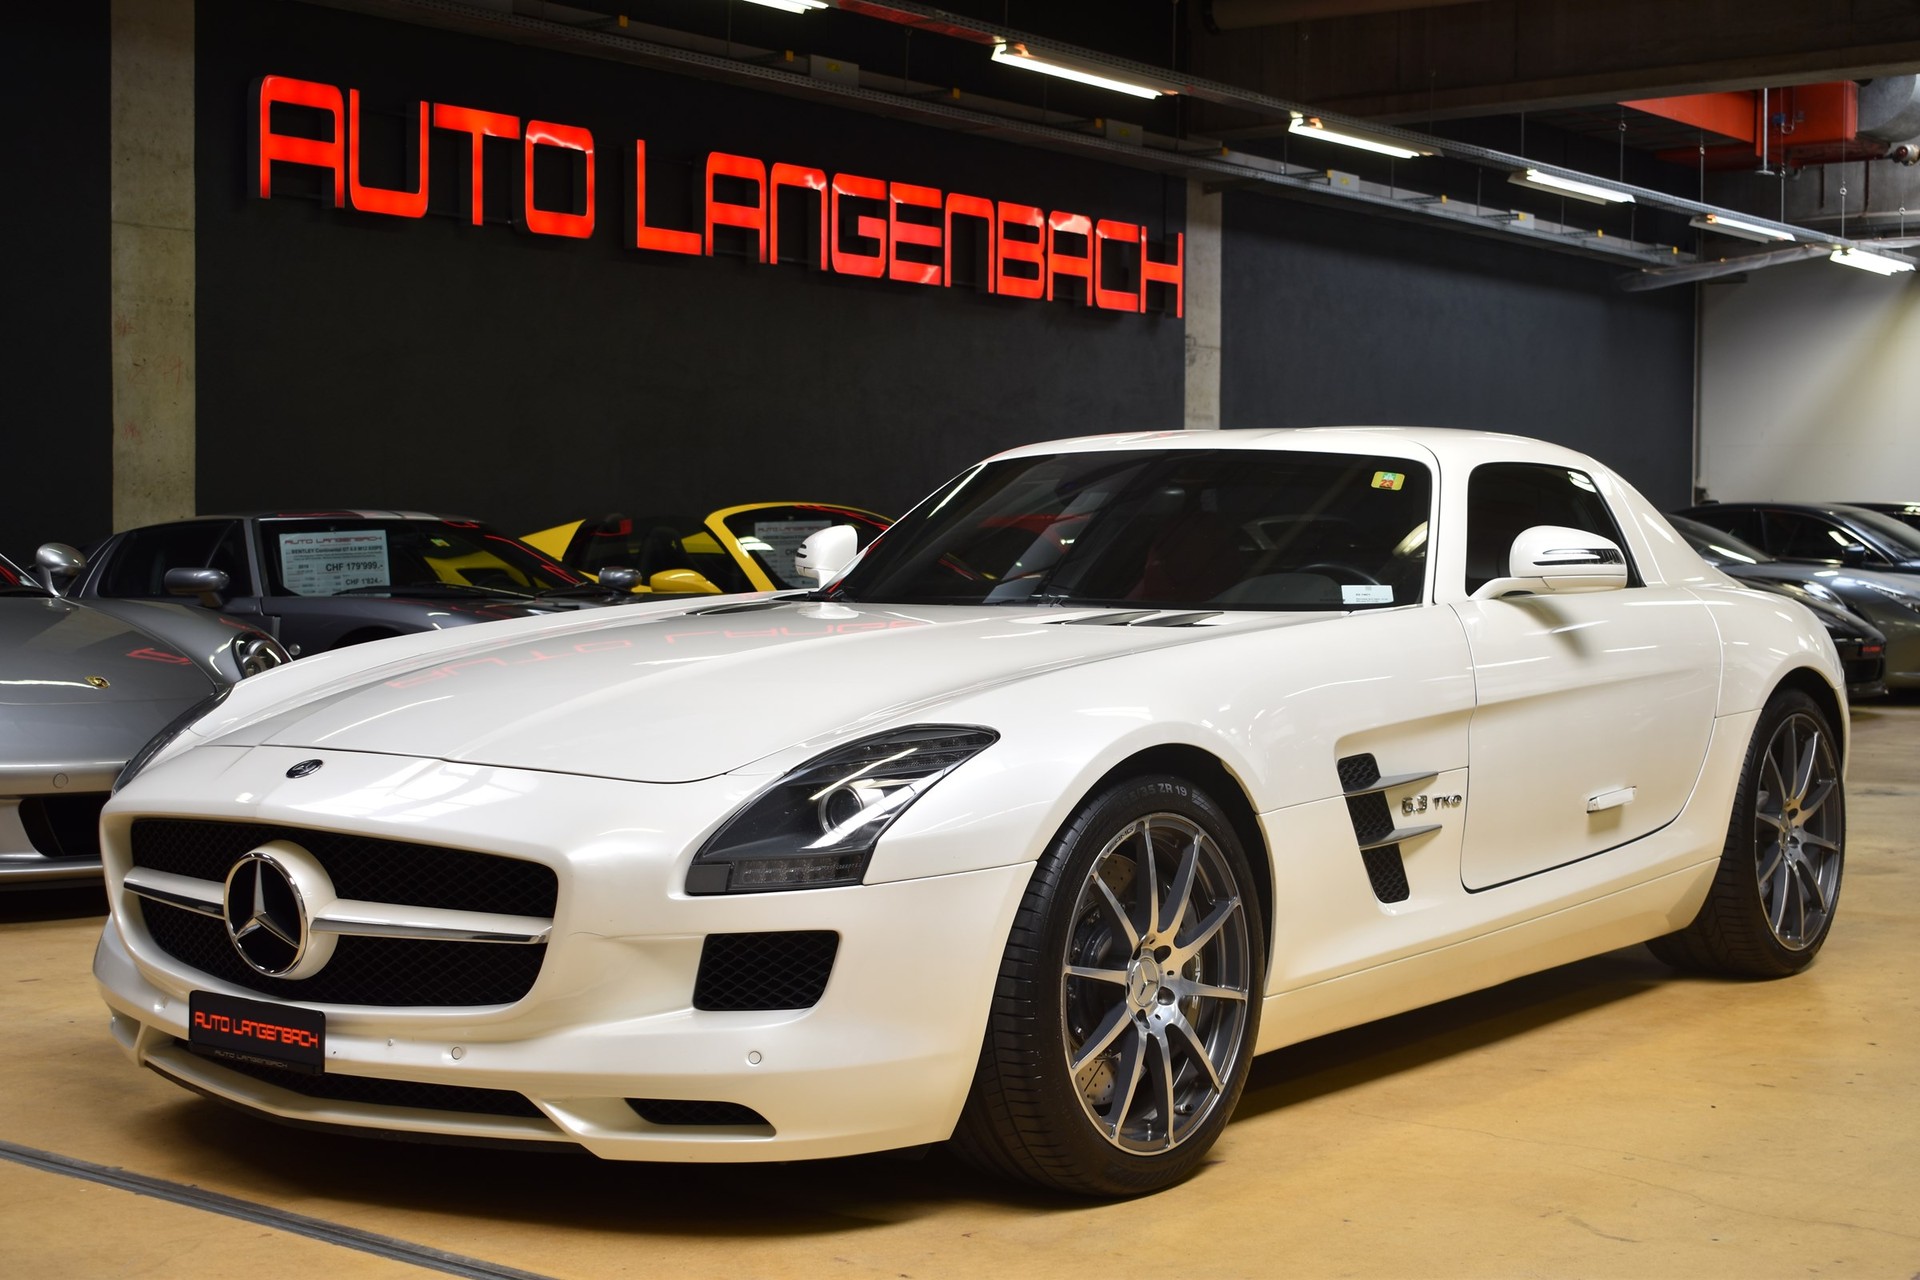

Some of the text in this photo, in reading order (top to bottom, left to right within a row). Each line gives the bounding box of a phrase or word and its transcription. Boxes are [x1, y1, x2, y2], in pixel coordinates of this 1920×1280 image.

[258, 74, 1184, 319] AUTO LANGENBACH
[316, 536, 382, 544] LANGENBACH
[326, 561, 383, 572] CHF 179'999.-
[346, 578, 361, 586] CHF
[1157, 782, 1174, 794] ZR
[1174, 784, 1188, 797] 19
[1402, 795, 1428, 815] 6.3
[194, 1011, 319, 1049] AUTO LANGENBACH
[214, 1049, 235, 1058] AUTO
